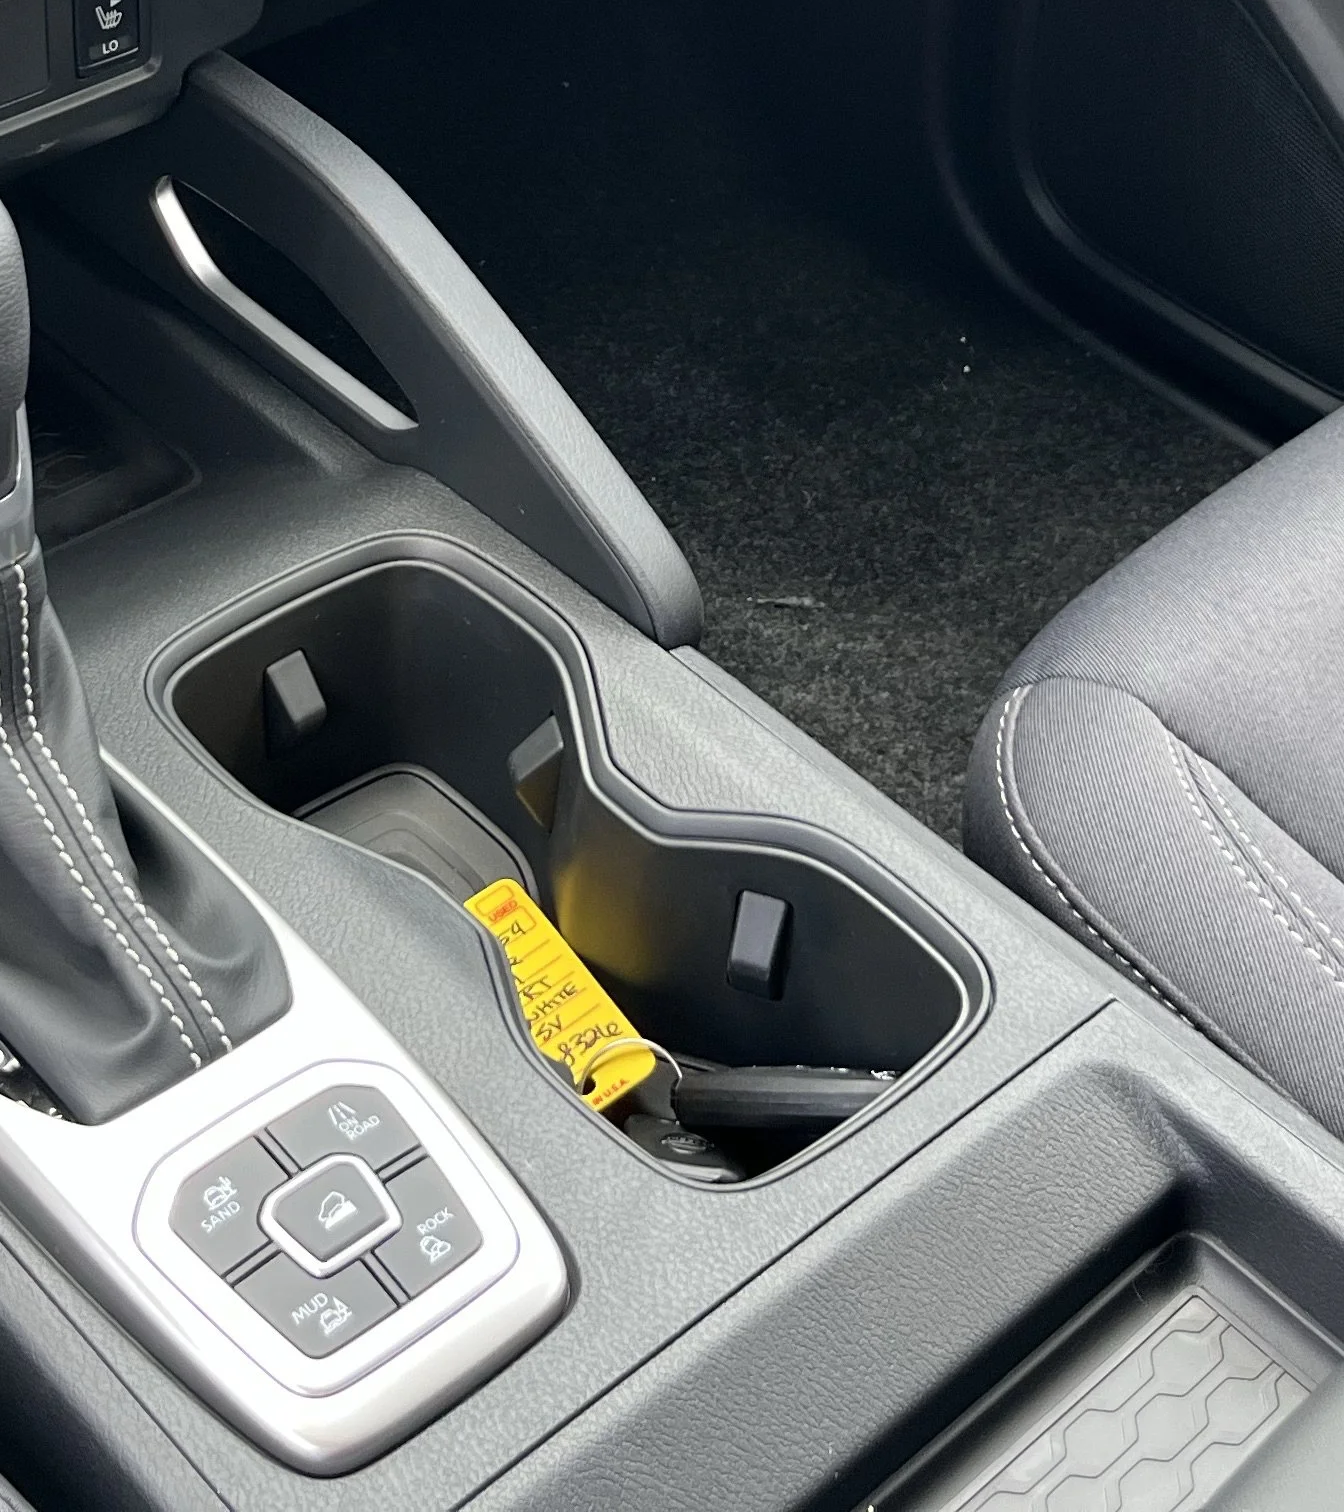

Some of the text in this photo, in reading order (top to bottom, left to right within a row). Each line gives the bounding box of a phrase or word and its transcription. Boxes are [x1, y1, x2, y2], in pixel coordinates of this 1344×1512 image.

[101, 38, 120, 55] LO
[339, 1116, 359, 1132] ON
[346, 1115, 380, 1141] ROAD
[200, 1201, 242, 1234] SAND
[416, 1206, 456, 1236] ROCK
[290, 1292, 329, 1326] MUD
